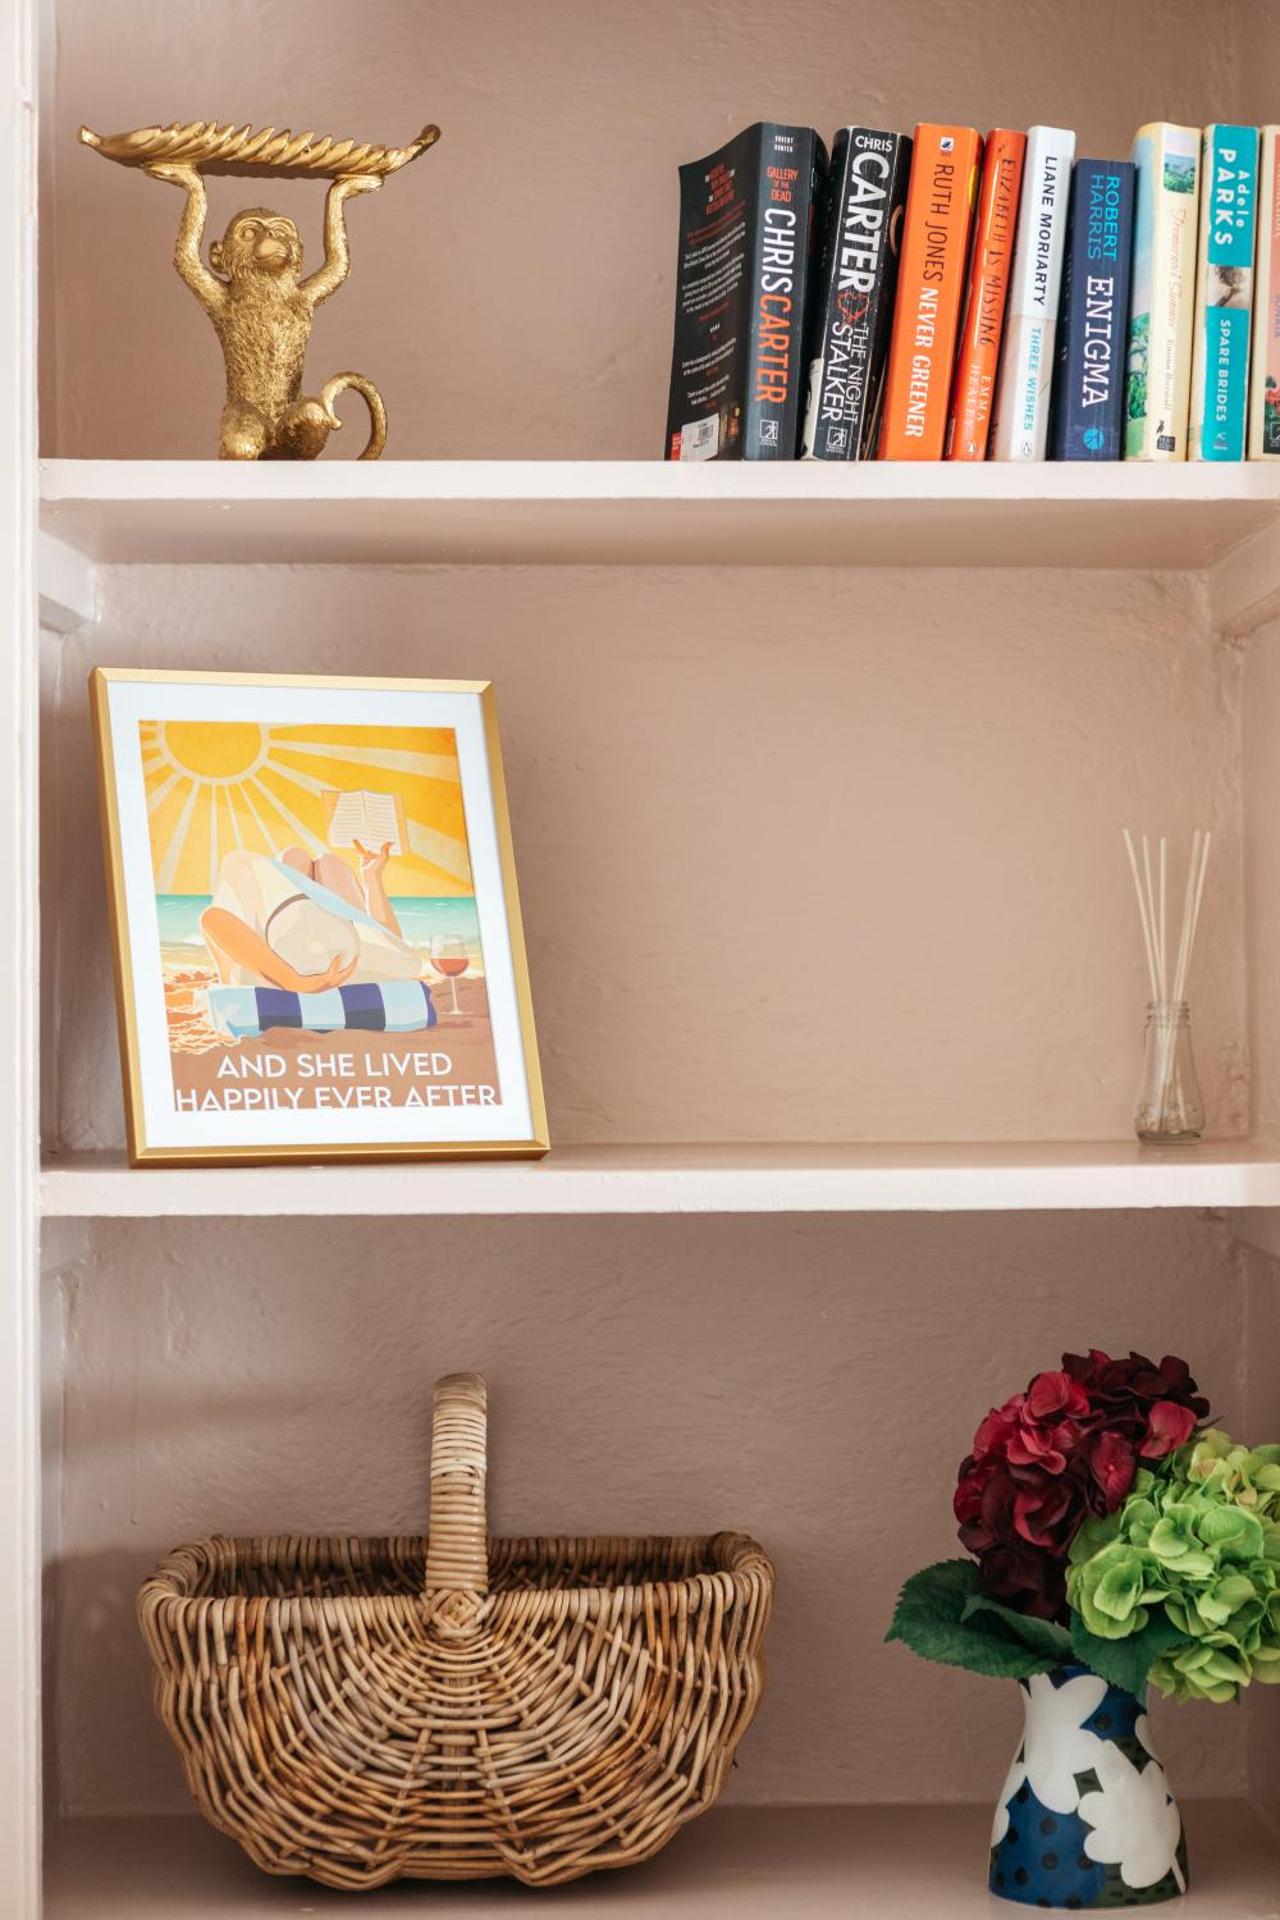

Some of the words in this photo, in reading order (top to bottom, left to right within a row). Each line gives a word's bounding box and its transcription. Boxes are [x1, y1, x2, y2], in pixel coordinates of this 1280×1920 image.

[855, 135, 893, 152] CHRIS
[767, 166, 798, 180] GALLERY
[771, 189, 791, 202] DEAD
[930, 164, 954, 215] RUTH
[992, 158, 1016, 243] ELIZABETH
[1041, 155, 1058, 207] LIANE
[1215, 148, 1236, 245] PARKS
[1236, 170, 1250, 227] Adele
[838, 151, 890, 293] CARTER
[1088, 174, 1104, 259] HARRIS
[1103, 175, 1120, 262] ROBERT
[923, 221, 948, 281] JONES
[988, 251, 1004, 266] IS
[1034, 213, 1052, 306] MORIARTY
[915, 287, 939, 348] NEVER
[979, 276, 1001, 347] MISSING
[850, 326, 869, 359] THE
[1029, 328, 1041, 372] THREE
[1082, 275, 1114, 408] ENIGMA
[1218, 319, 1231, 365] SPARE
[821, 321, 854, 421] STALKER
[843, 365, 864, 425] NIGHT
[905, 355, 931, 438] GREENER
[977, 375, 991, 421] EMMA
[1216, 369, 1229, 422] BRIDES
[1023, 376, 1036, 431] WISHES
[217, 1054, 286, 1078] AND
[297, 1053, 355, 1078] SHE
[365, 1053, 452, 1076] LIVED
[175, 1087, 304, 1111] HAPPILY
[315, 1086, 392, 1108] EVER
[404, 1085, 496, 1106] AFTER
